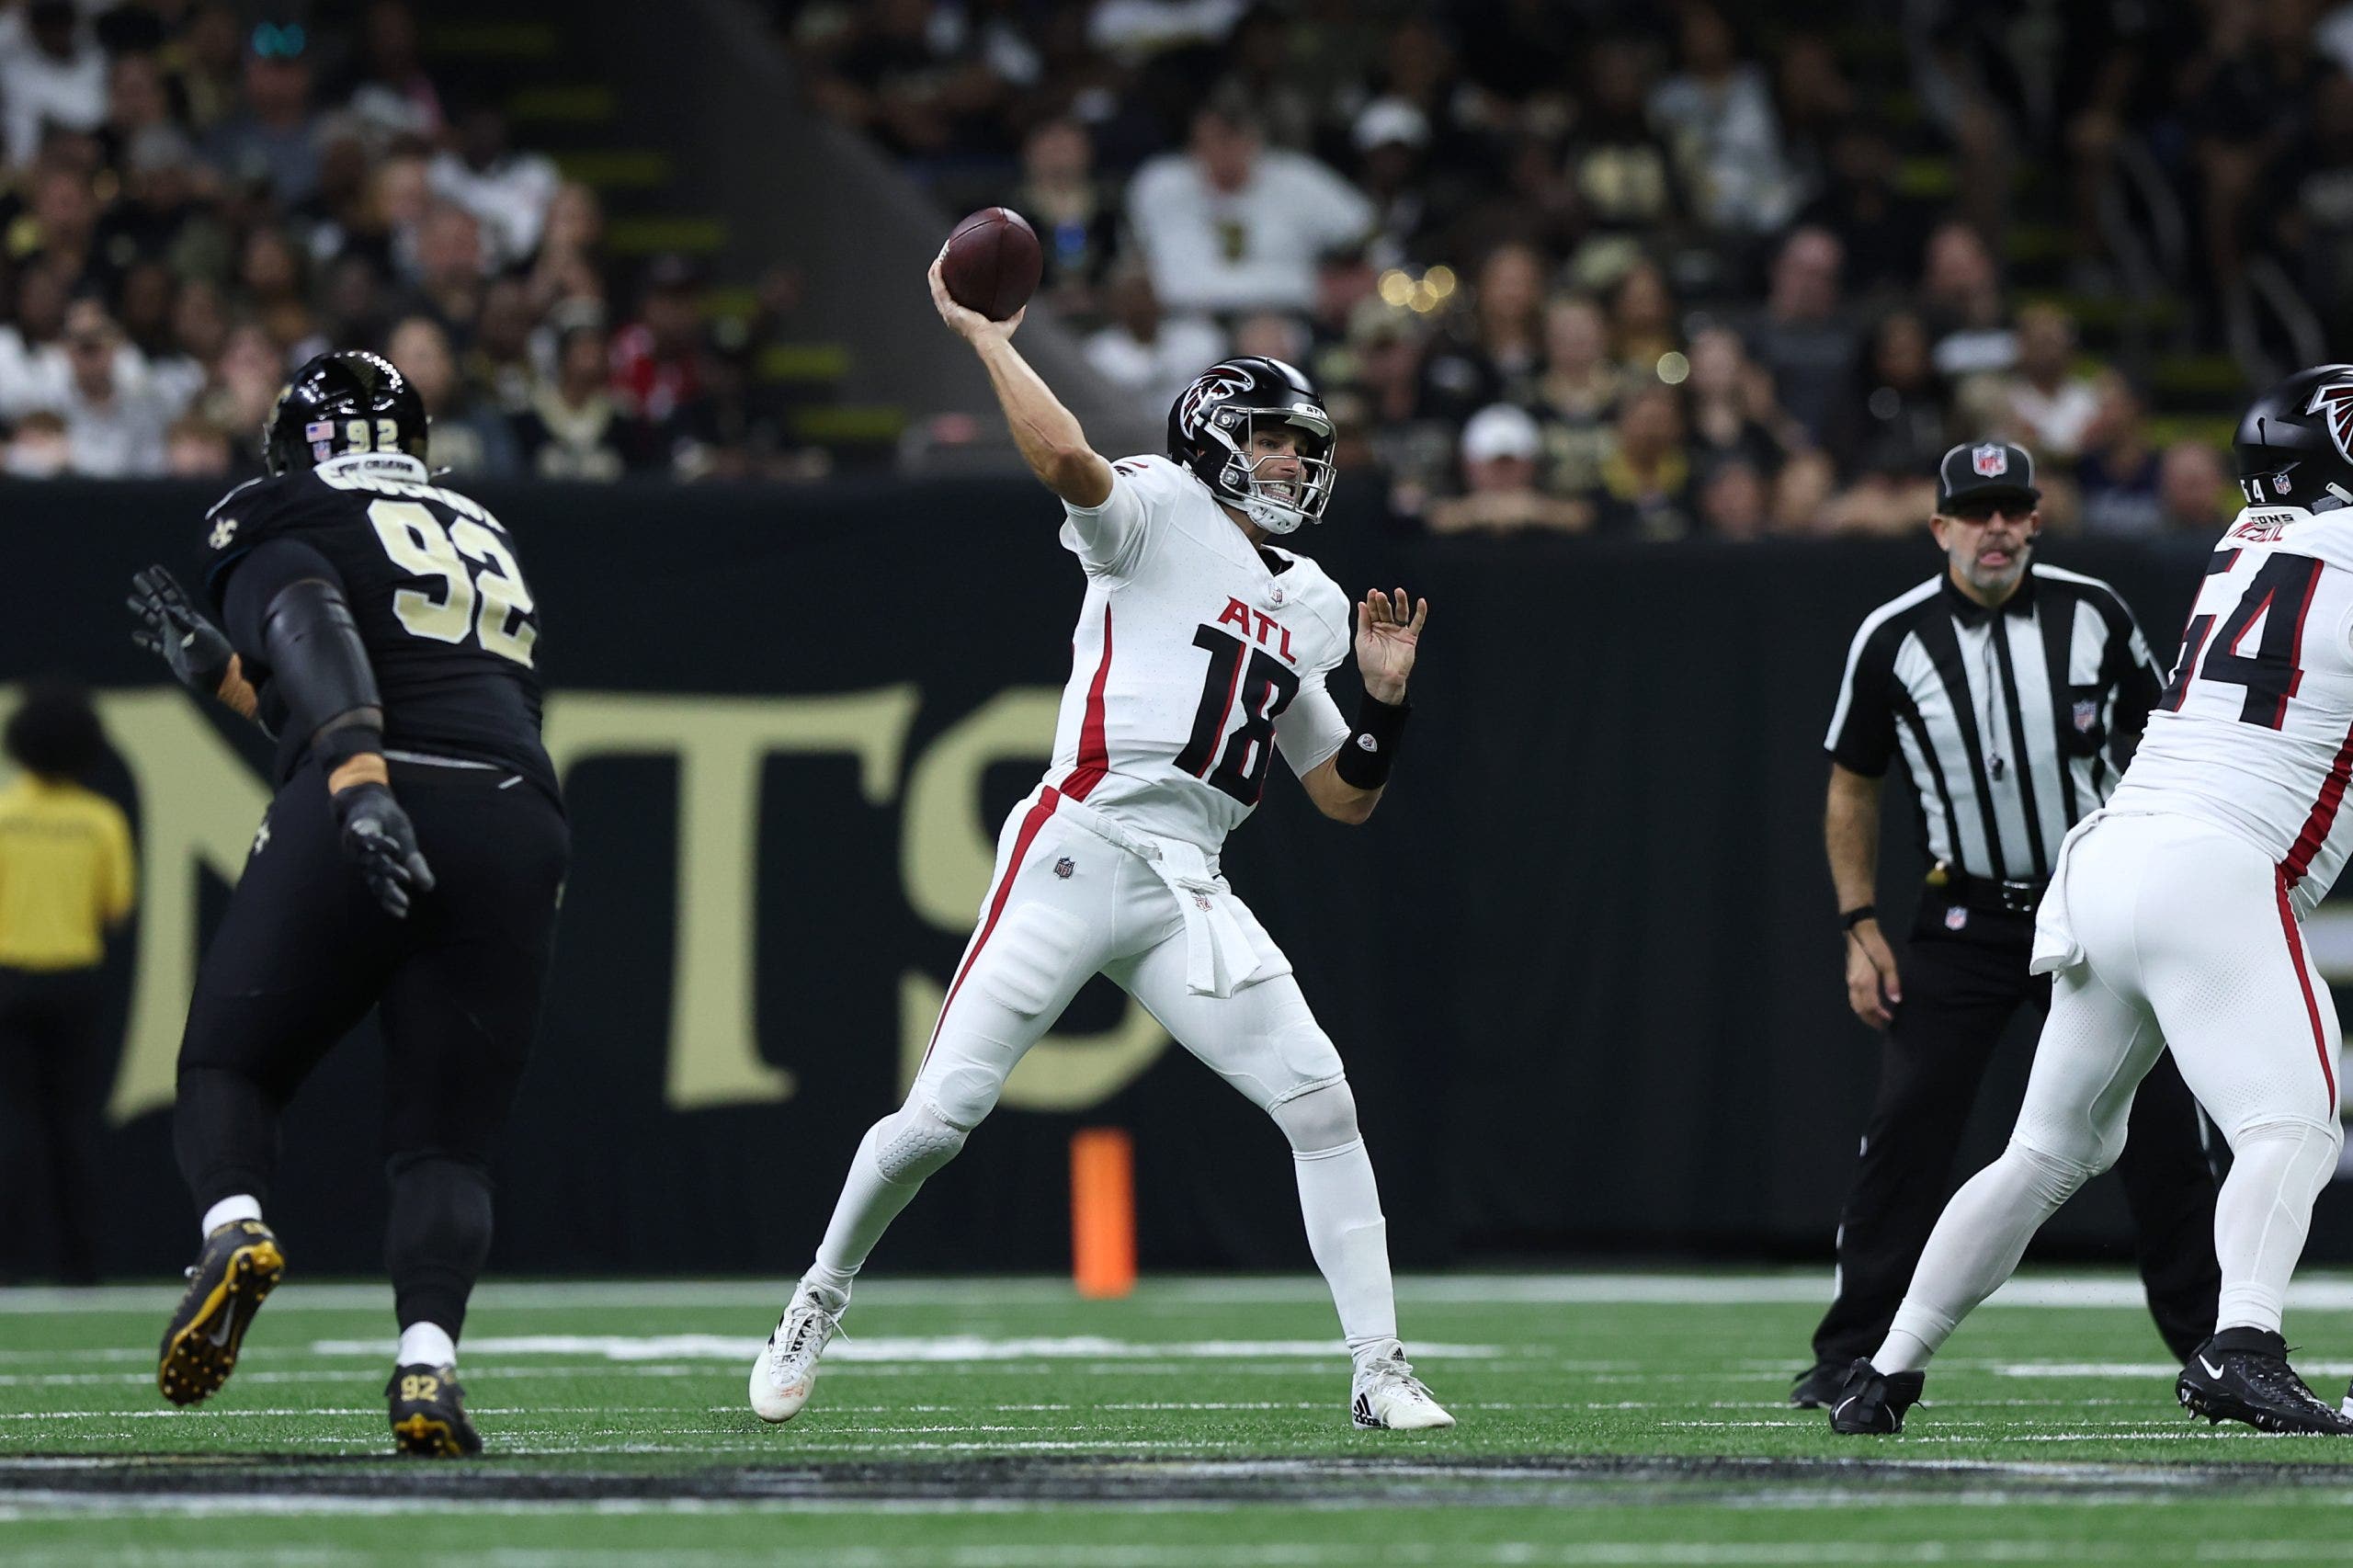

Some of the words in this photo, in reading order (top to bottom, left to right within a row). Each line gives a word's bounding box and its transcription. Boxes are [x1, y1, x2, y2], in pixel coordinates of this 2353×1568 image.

[347, 419, 398, 453] 92
[368, 499, 537, 669] 92
[1217, 595, 1297, 665] ATL
[1172, 623, 1301, 807] 18
[401, 1375, 438, 1403] 92
